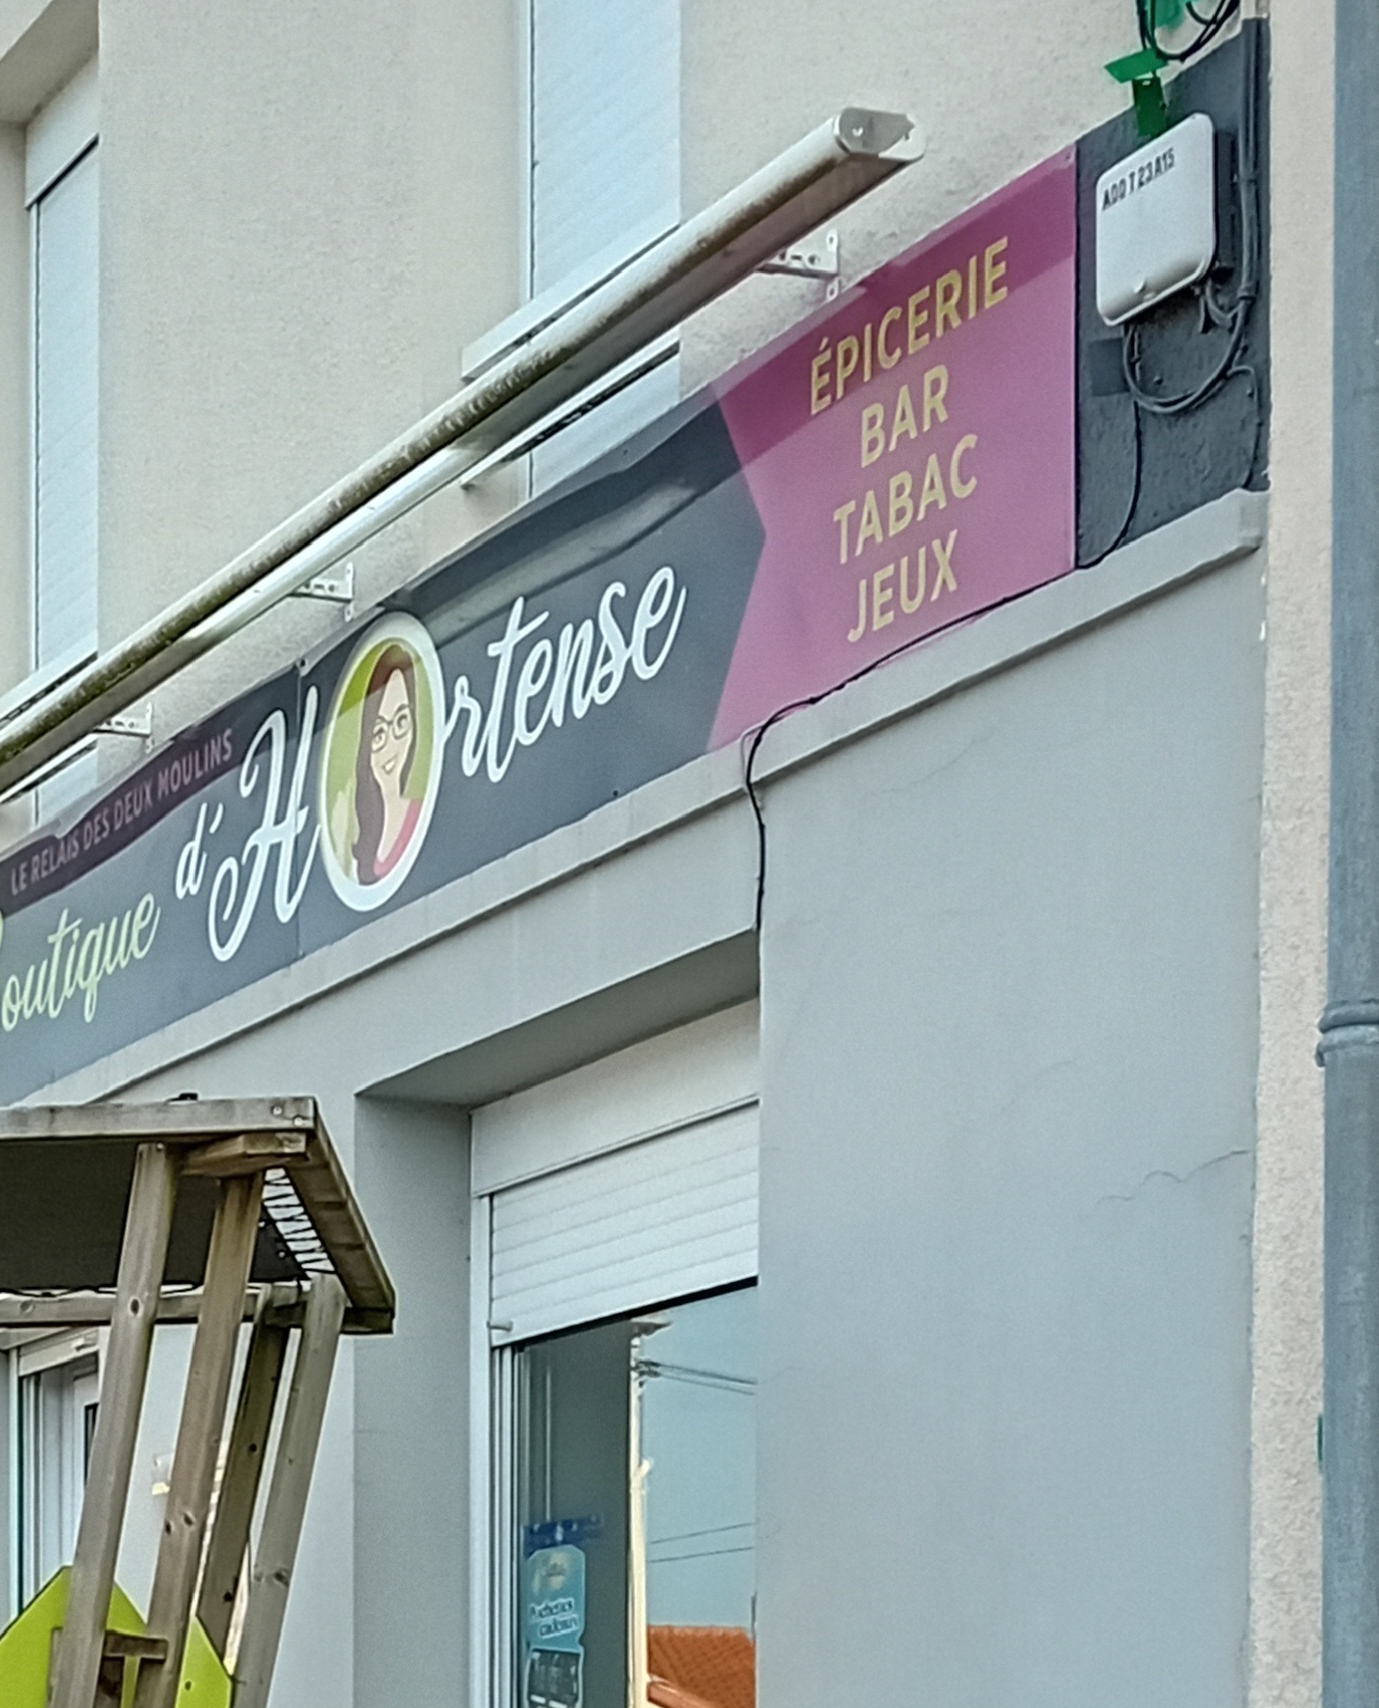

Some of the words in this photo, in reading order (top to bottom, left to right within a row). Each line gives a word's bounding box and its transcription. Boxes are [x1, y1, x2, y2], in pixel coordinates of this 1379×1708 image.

[810, 235, 1009, 417] ÉPICERIE
[860, 364, 949, 468] BAR
[833, 434, 978, 565] TABAC
[847, 528, 958, 643] JEUX
[10, 861, 28, 896] LE
[29, 829, 80, 884] RELAIS
[83, 806, 111, 851] DES
[113, 779, 154, 831] DEUX
[157, 728, 233, 800] MOULINS
